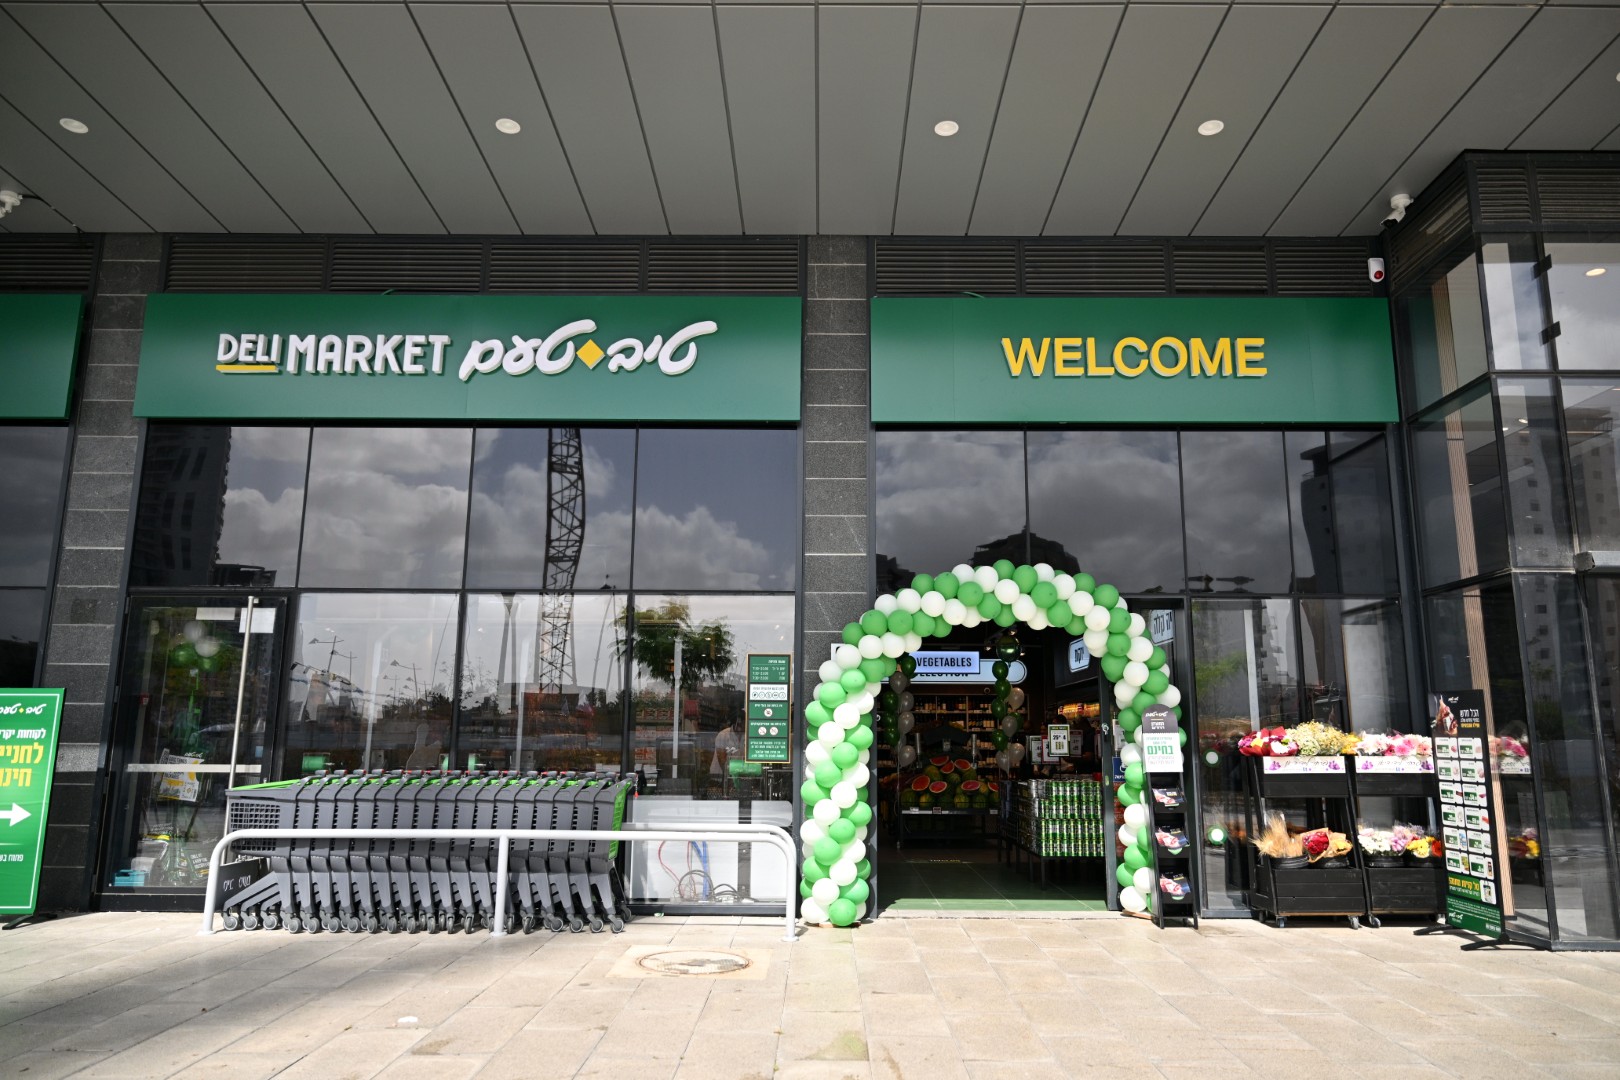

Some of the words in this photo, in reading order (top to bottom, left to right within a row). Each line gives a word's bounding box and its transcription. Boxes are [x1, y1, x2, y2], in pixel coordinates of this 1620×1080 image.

[217, 333, 282, 363] DELI
[287, 334, 451, 374] MARKET
[458, 318, 597, 381] טעם
[1001, 336, 1268, 377] WELCOME
[916, 657, 972, 667] VEGETABLES
[0, 729, 16, 740] יקר
[1147, 745, 1174, 755] בחינם
